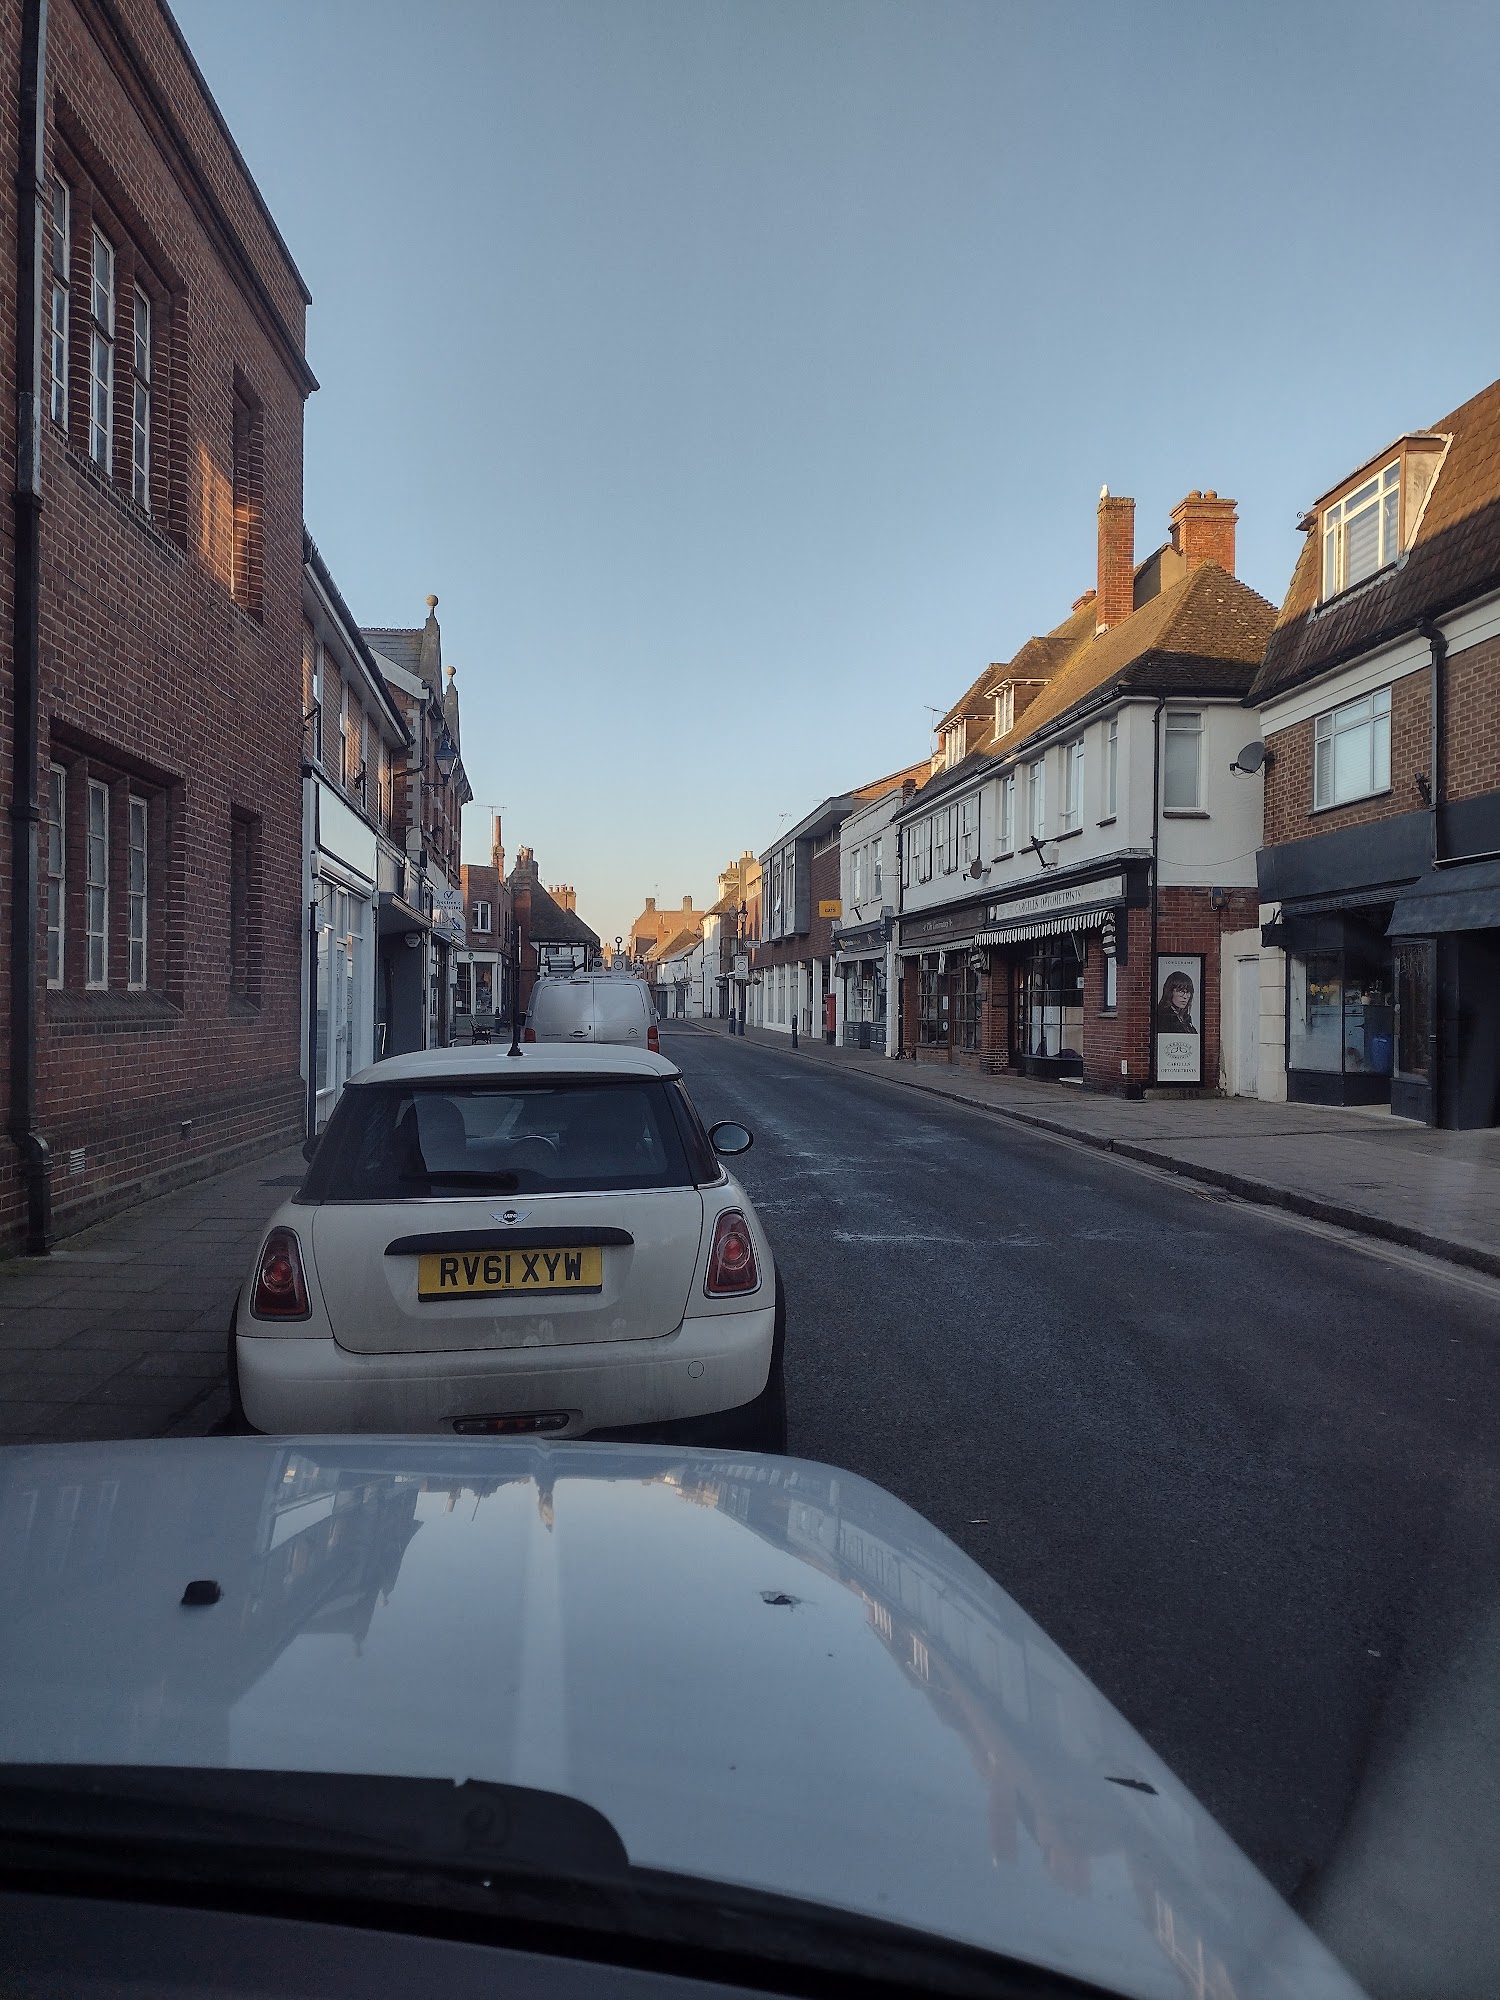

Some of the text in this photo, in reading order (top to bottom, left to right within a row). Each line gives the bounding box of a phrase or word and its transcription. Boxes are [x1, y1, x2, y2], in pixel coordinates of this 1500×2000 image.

[1014, 898, 1039, 914] CARGILLS
[1040, 889, 1082, 910] OPTOMETRISTS
[440, 1252, 582, 1287] RV61 XYW
